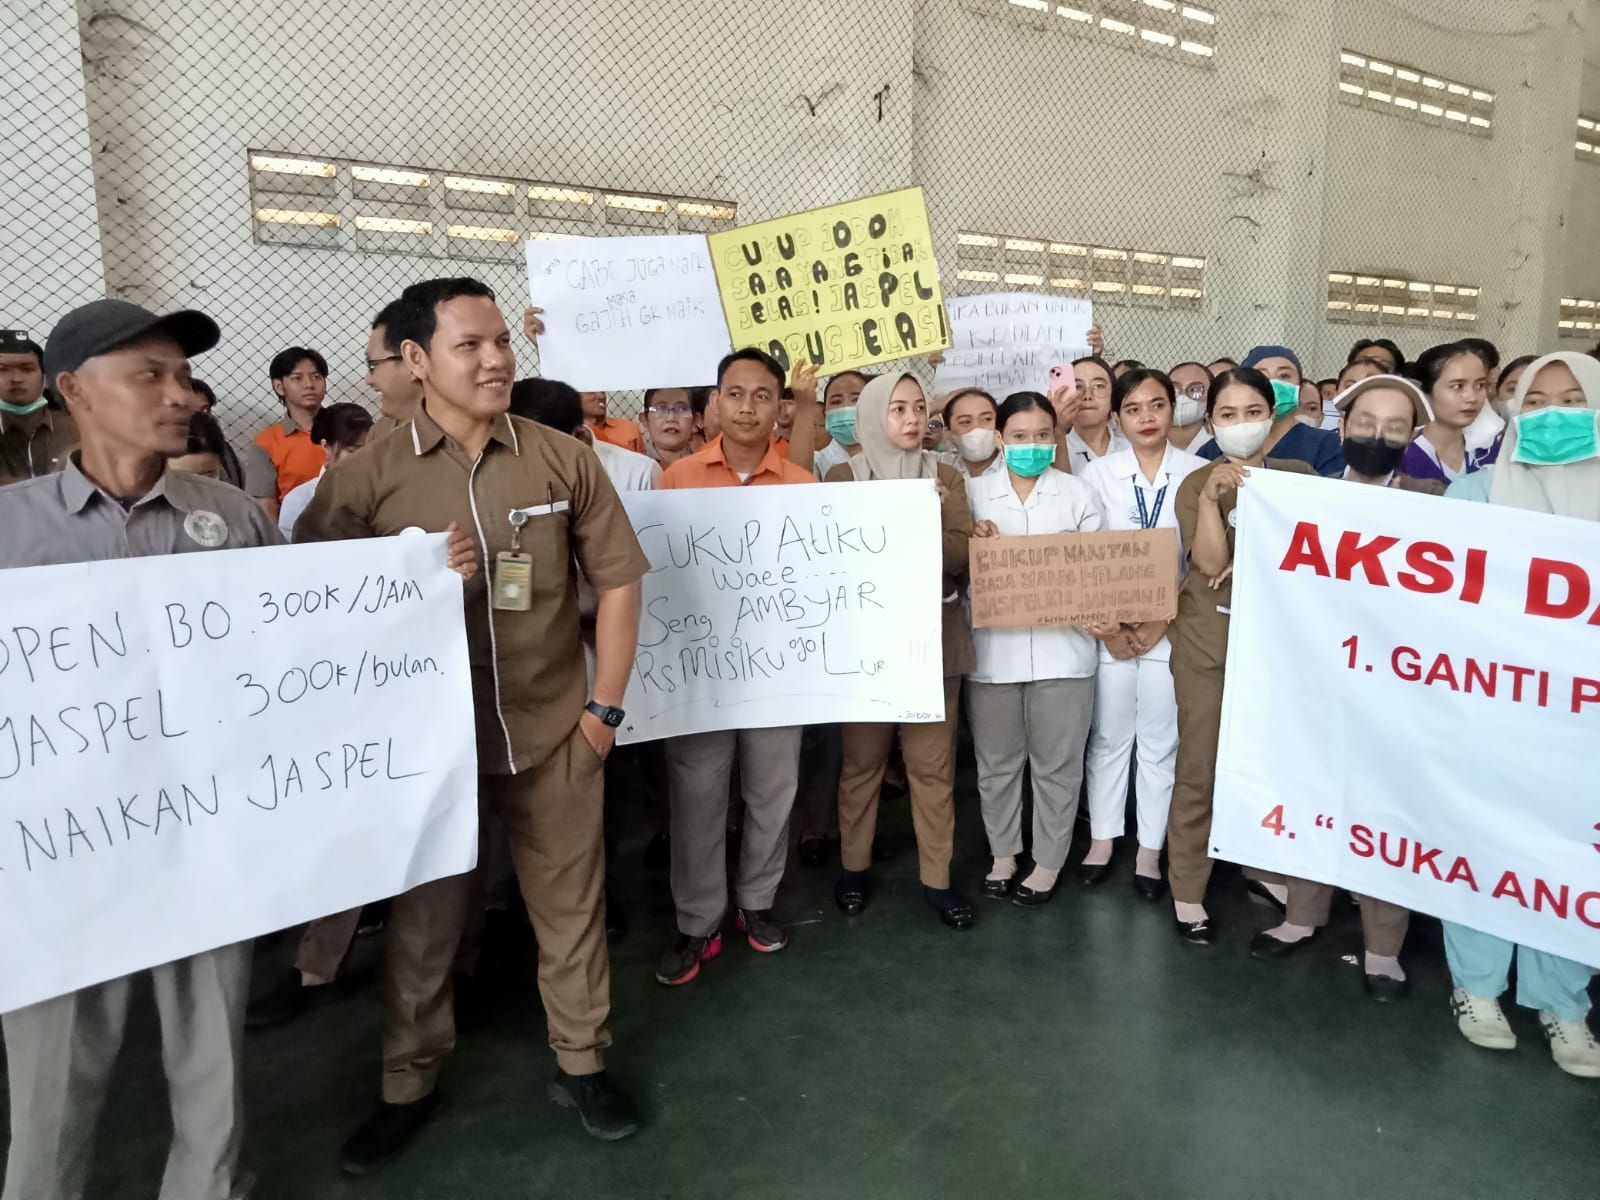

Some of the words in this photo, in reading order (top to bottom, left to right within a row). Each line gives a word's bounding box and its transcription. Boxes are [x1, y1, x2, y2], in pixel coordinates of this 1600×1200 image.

[724, 228, 811, 271] CUKUP
[821, 208, 904, 252] JODOH
[732, 266, 793, 300] SAJA
[797, 252, 863, 286] YANG
[830, 269, 933, 312] JASPEL
[849, 304, 948, 359] JELAS!
[1063, 540, 1152, 565] MANTAN
[1279, 520, 1488, 604] AKSI
[1525, 557, 1600, 627] D
[637, 596, 713, 648] Seng
[1341, 634, 1374, 673] 1.
[1391, 645, 1549, 708] GANTI
[16, 775, 220, 872] NAIKAN
[248, 738, 430, 811] JASPEL
[1261, 804, 1296, 839] 4.
[1349, 823, 1480, 893] SUKA
